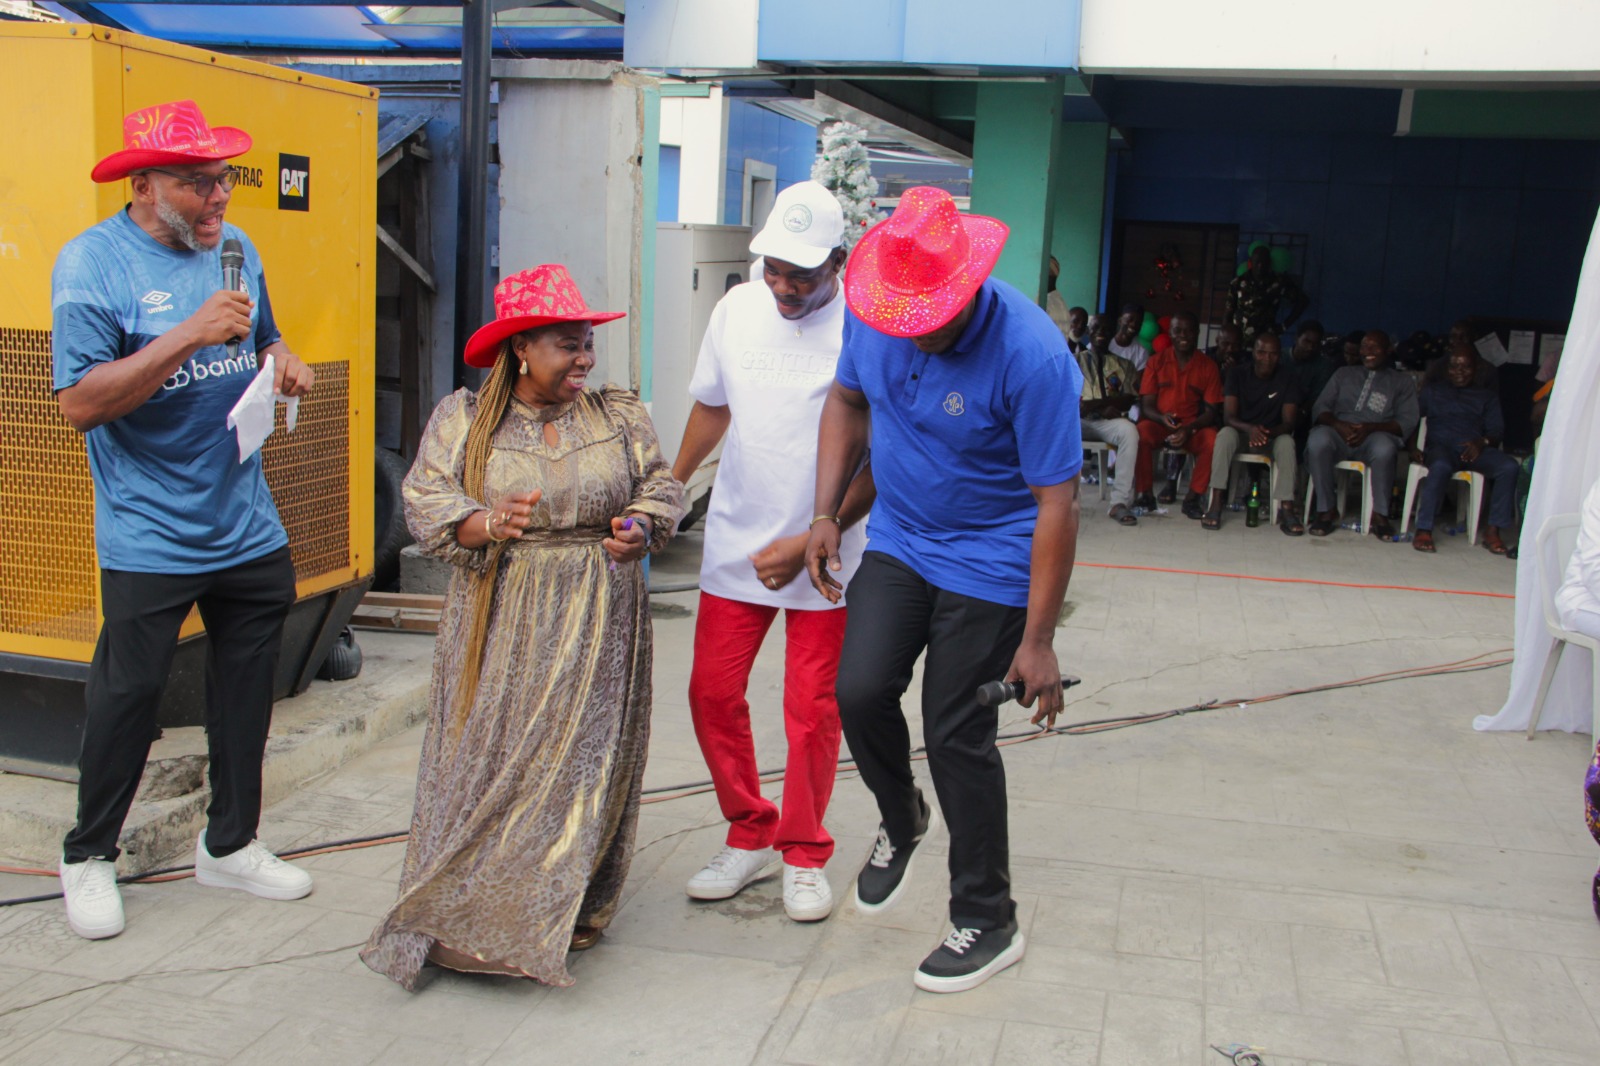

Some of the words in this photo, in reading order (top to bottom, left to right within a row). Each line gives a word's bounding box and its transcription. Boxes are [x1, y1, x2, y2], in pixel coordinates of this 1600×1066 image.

[228, 165, 263, 188] NTRAC
[281, 168, 308, 197] CAT
[147, 304, 174, 314] umbro
